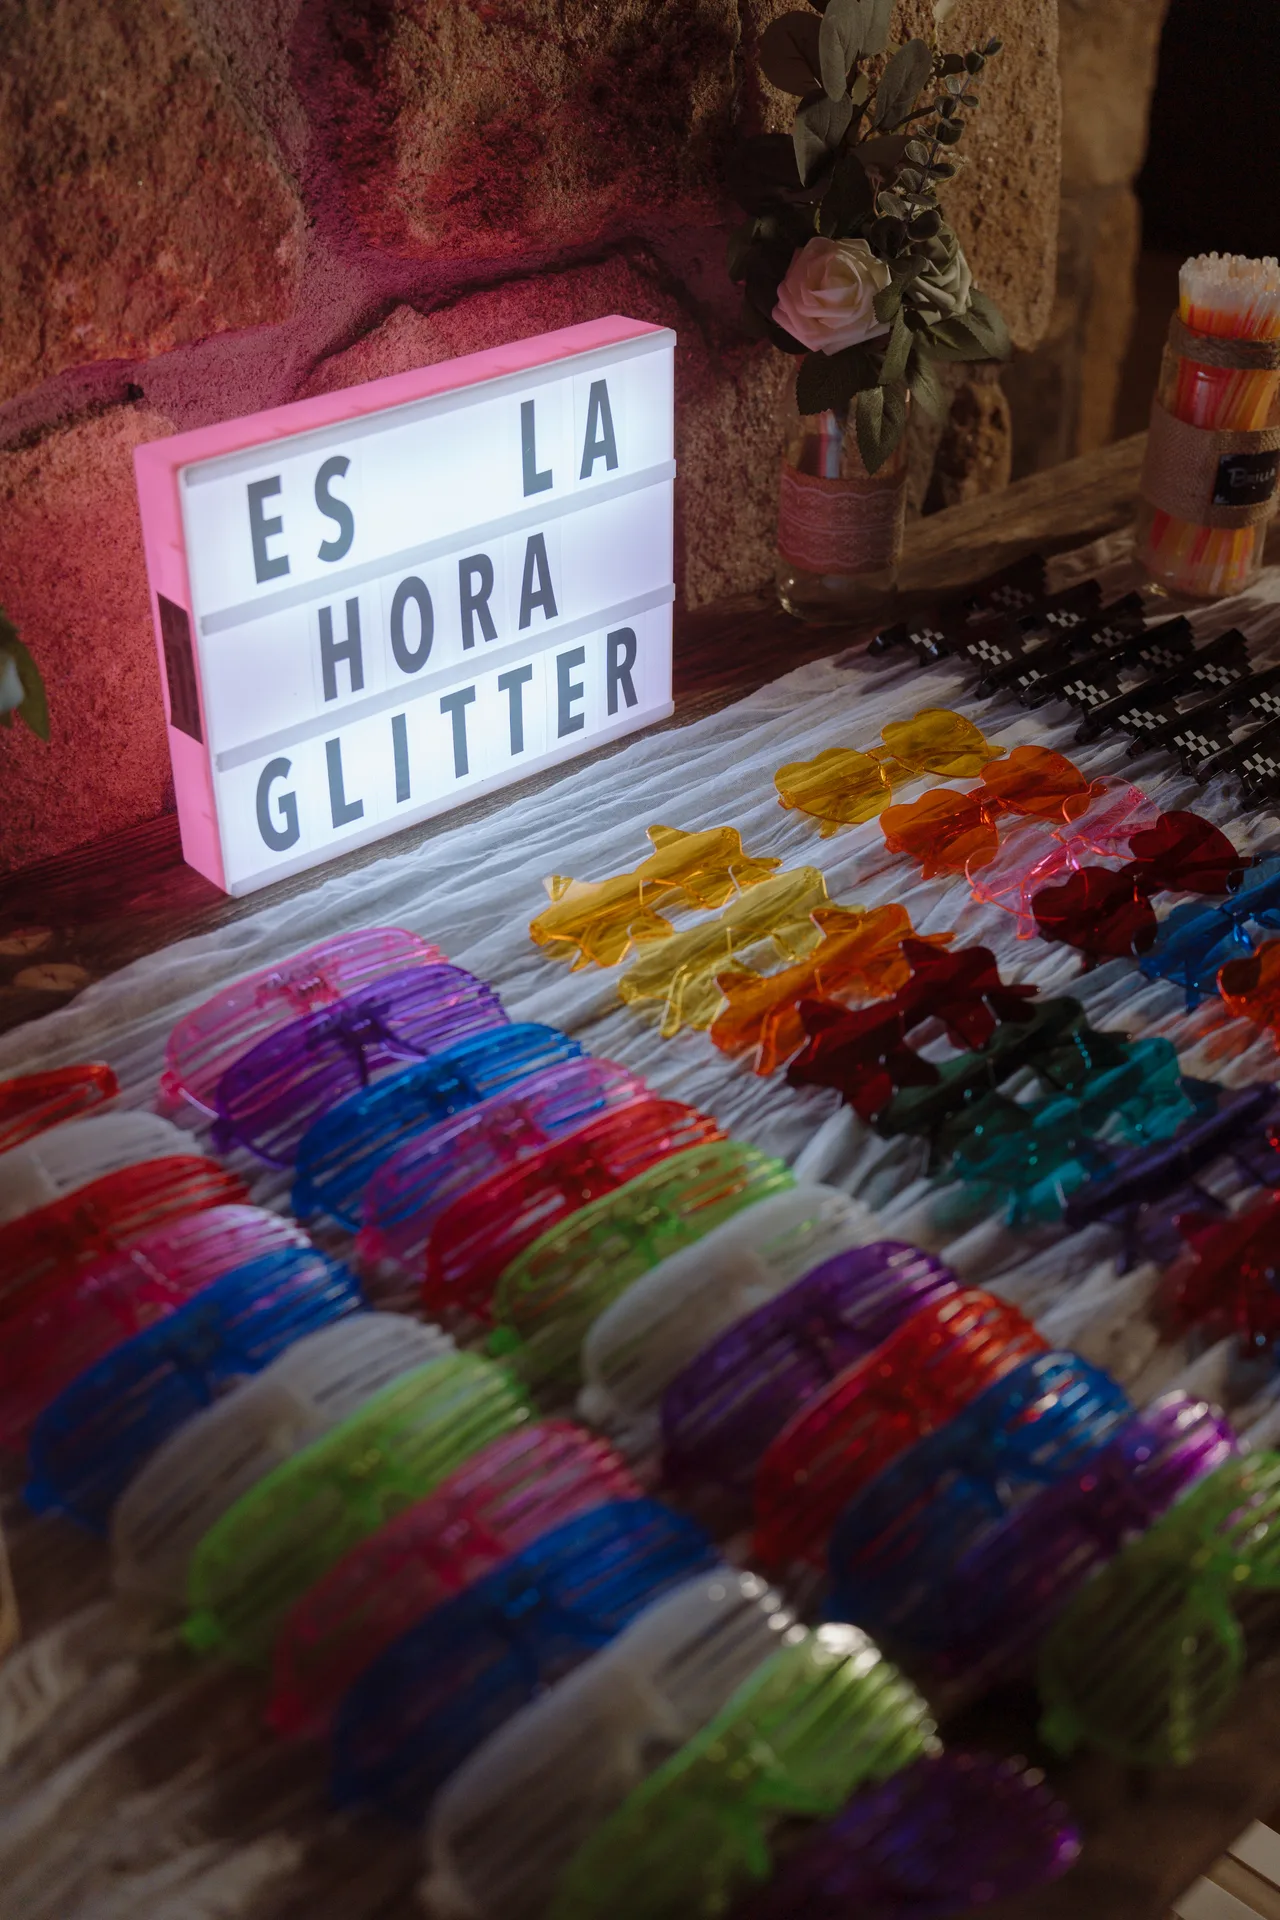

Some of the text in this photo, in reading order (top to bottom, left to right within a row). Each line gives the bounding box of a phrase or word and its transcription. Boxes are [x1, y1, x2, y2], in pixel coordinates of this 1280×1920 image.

[246, 378, 619, 584] ES LA
[317, 532, 559, 702] HORA
[255, 626, 639, 852] GLITTER
